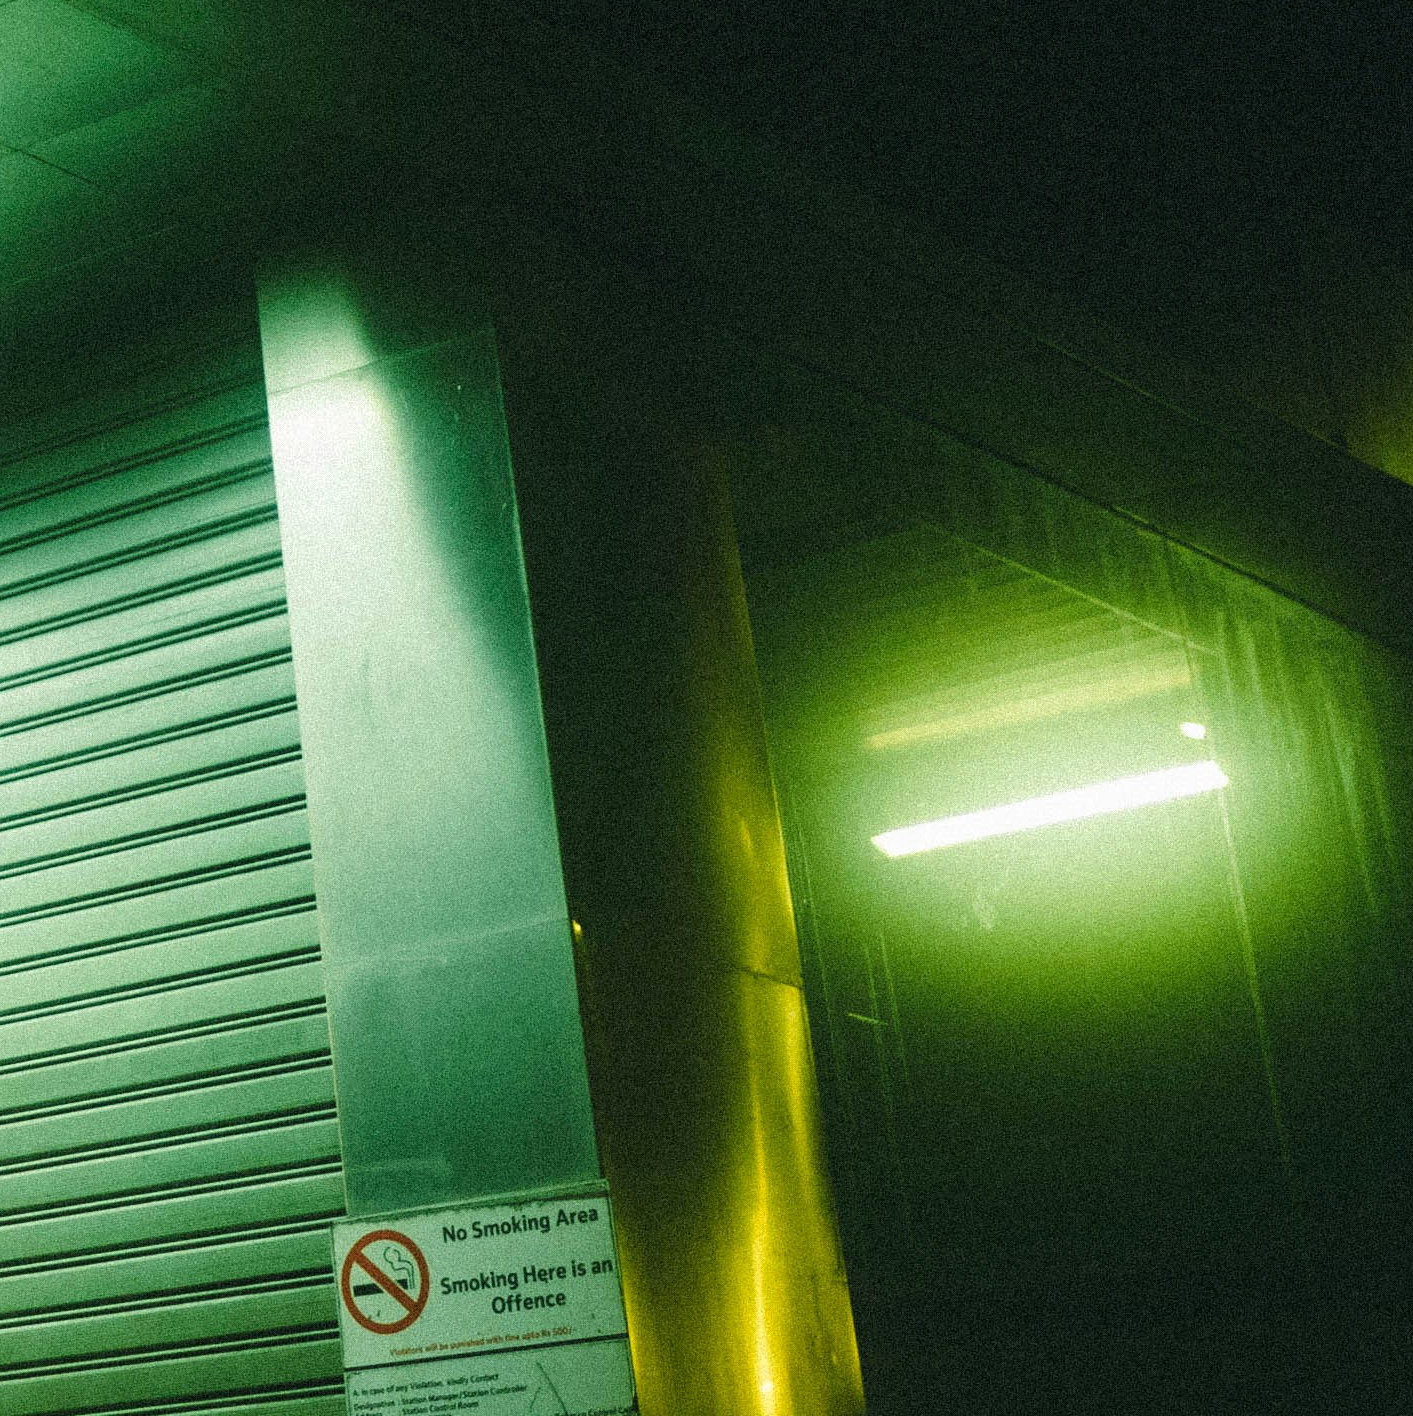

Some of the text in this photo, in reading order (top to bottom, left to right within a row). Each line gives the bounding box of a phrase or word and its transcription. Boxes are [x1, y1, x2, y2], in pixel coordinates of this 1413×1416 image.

[442, 1208, 599, 1243] No Smoking Area
[440, 1259, 613, 1295] Smoking Here is an
[491, 1292, 566, 1314] Offence
